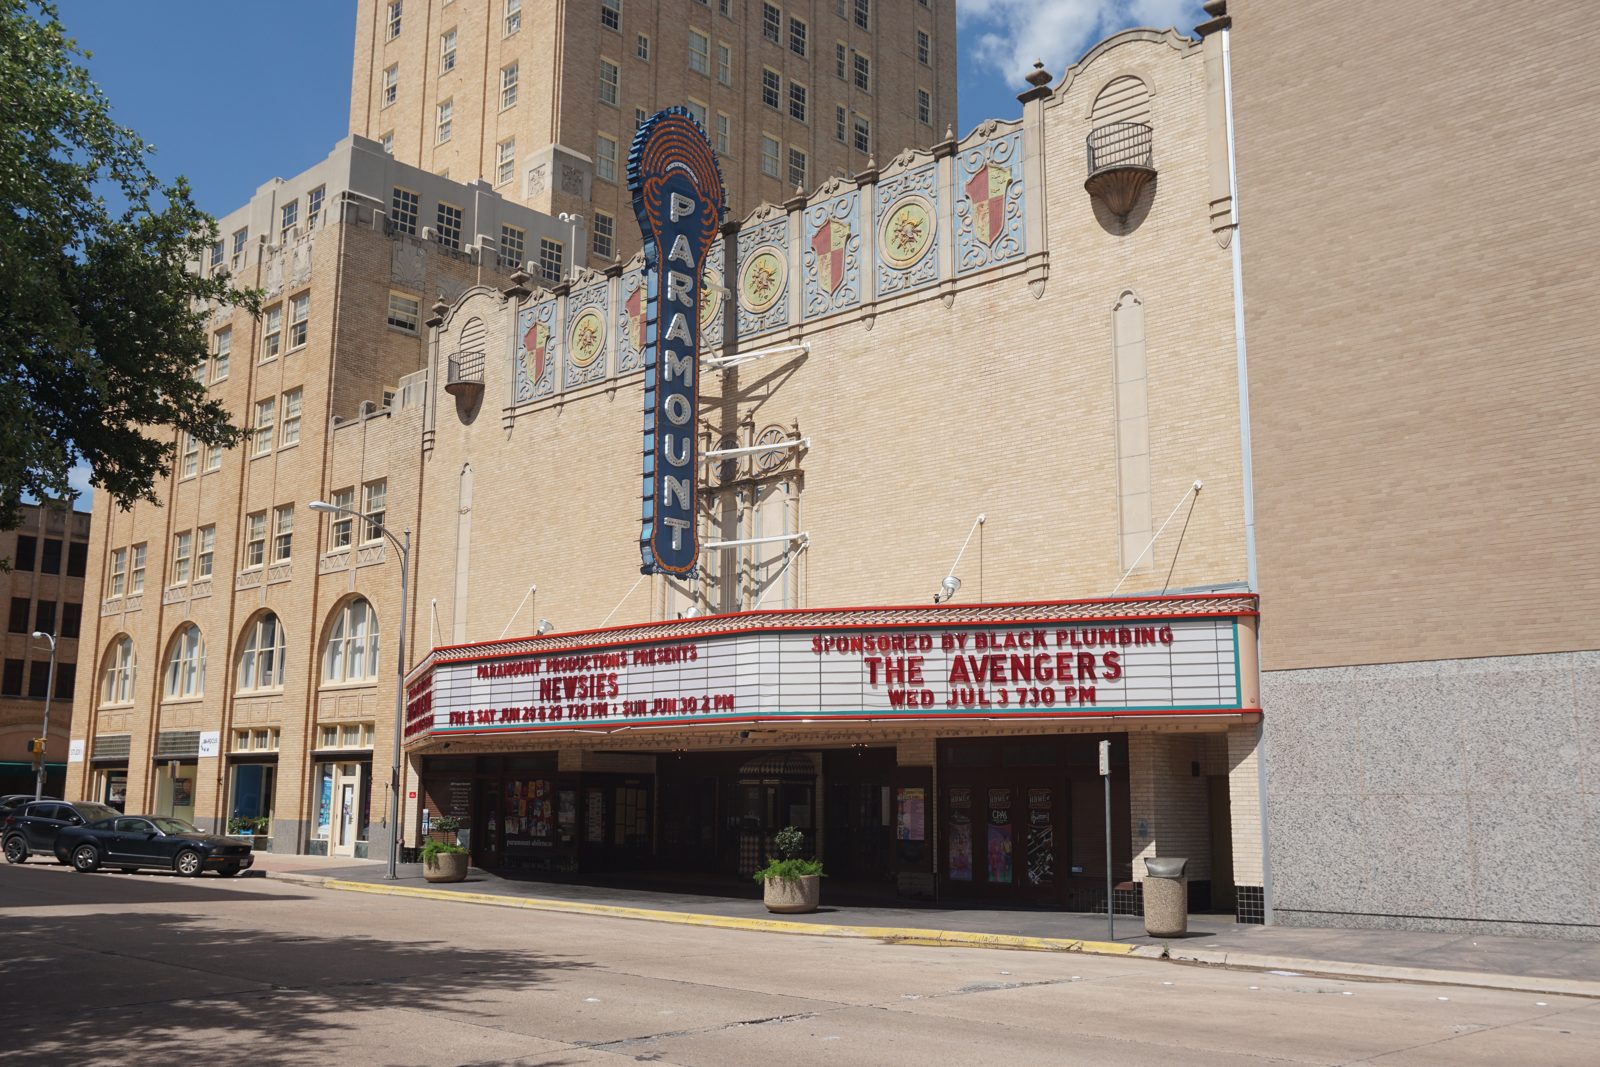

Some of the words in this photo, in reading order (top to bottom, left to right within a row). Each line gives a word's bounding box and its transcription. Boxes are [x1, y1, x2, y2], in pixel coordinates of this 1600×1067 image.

[664, 192, 695, 551] PARAMOUNT
[812, 634, 933, 654] SPONSORED
[942, 633, 967, 651] BY
[975, 629, 1047, 650] BLACK
[1056, 626, 1174, 647] PLUMBING
[477, 660, 540, 679] PARAMOUNT
[547, 651, 627, 673] PRODUCTIONS
[633, 645, 697, 666] PRESENTS
[865, 657, 925, 685] THE
[949, 651, 1122, 683] AVENGERS
[540, 673, 619, 703] NEWSIES
[888, 689, 934, 709] WED
[946, 688, 991, 707] JUL
[997, 687, 1010, 706] 3
[1016, 687, 1056, 706] 730
[1065, 686, 1096, 705] PM
[450, 711, 465, 726] FRI
[477, 709, 496, 724] SAT
[499, 707, 520, 723] JUN
[591, 702, 608, 718] PM
[623, 700, 646, 717] SUN
[651, 698, 676, 715] JUN
[681, 697, 697, 715] 30
[701, 695, 710, 713] 2
[714, 694, 734, 712] PM
